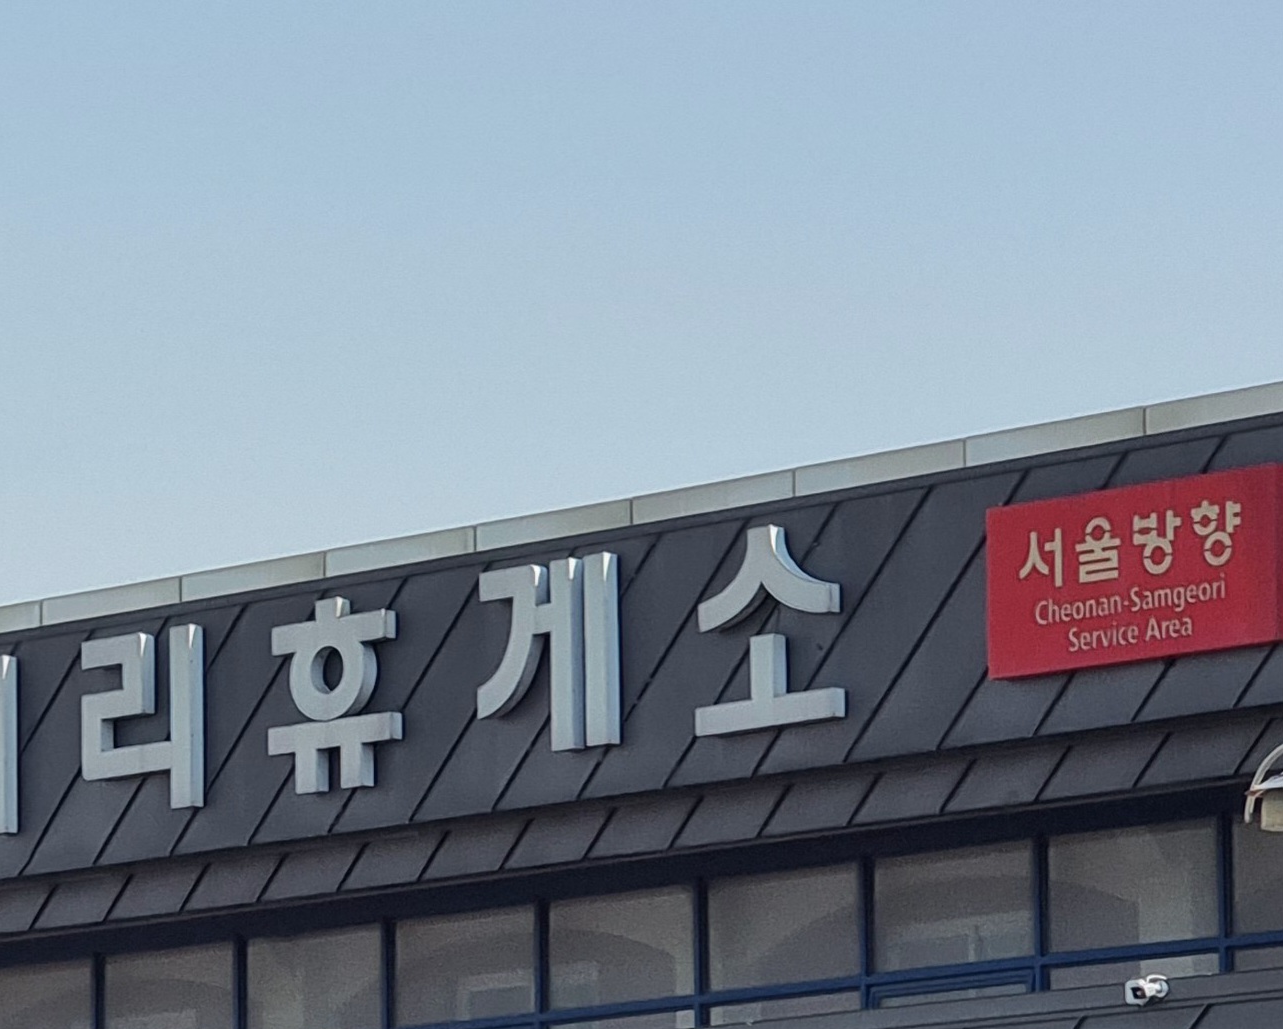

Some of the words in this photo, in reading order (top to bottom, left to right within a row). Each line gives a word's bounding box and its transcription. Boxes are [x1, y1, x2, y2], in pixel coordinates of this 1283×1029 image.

[1019, 500, 1242, 588] 서울방향
[1035, 573, 1226, 626] Cheonan-Samgeori
[1068, 622, 1139, 652] Service
[1145, 617, 1193, 642] Area
